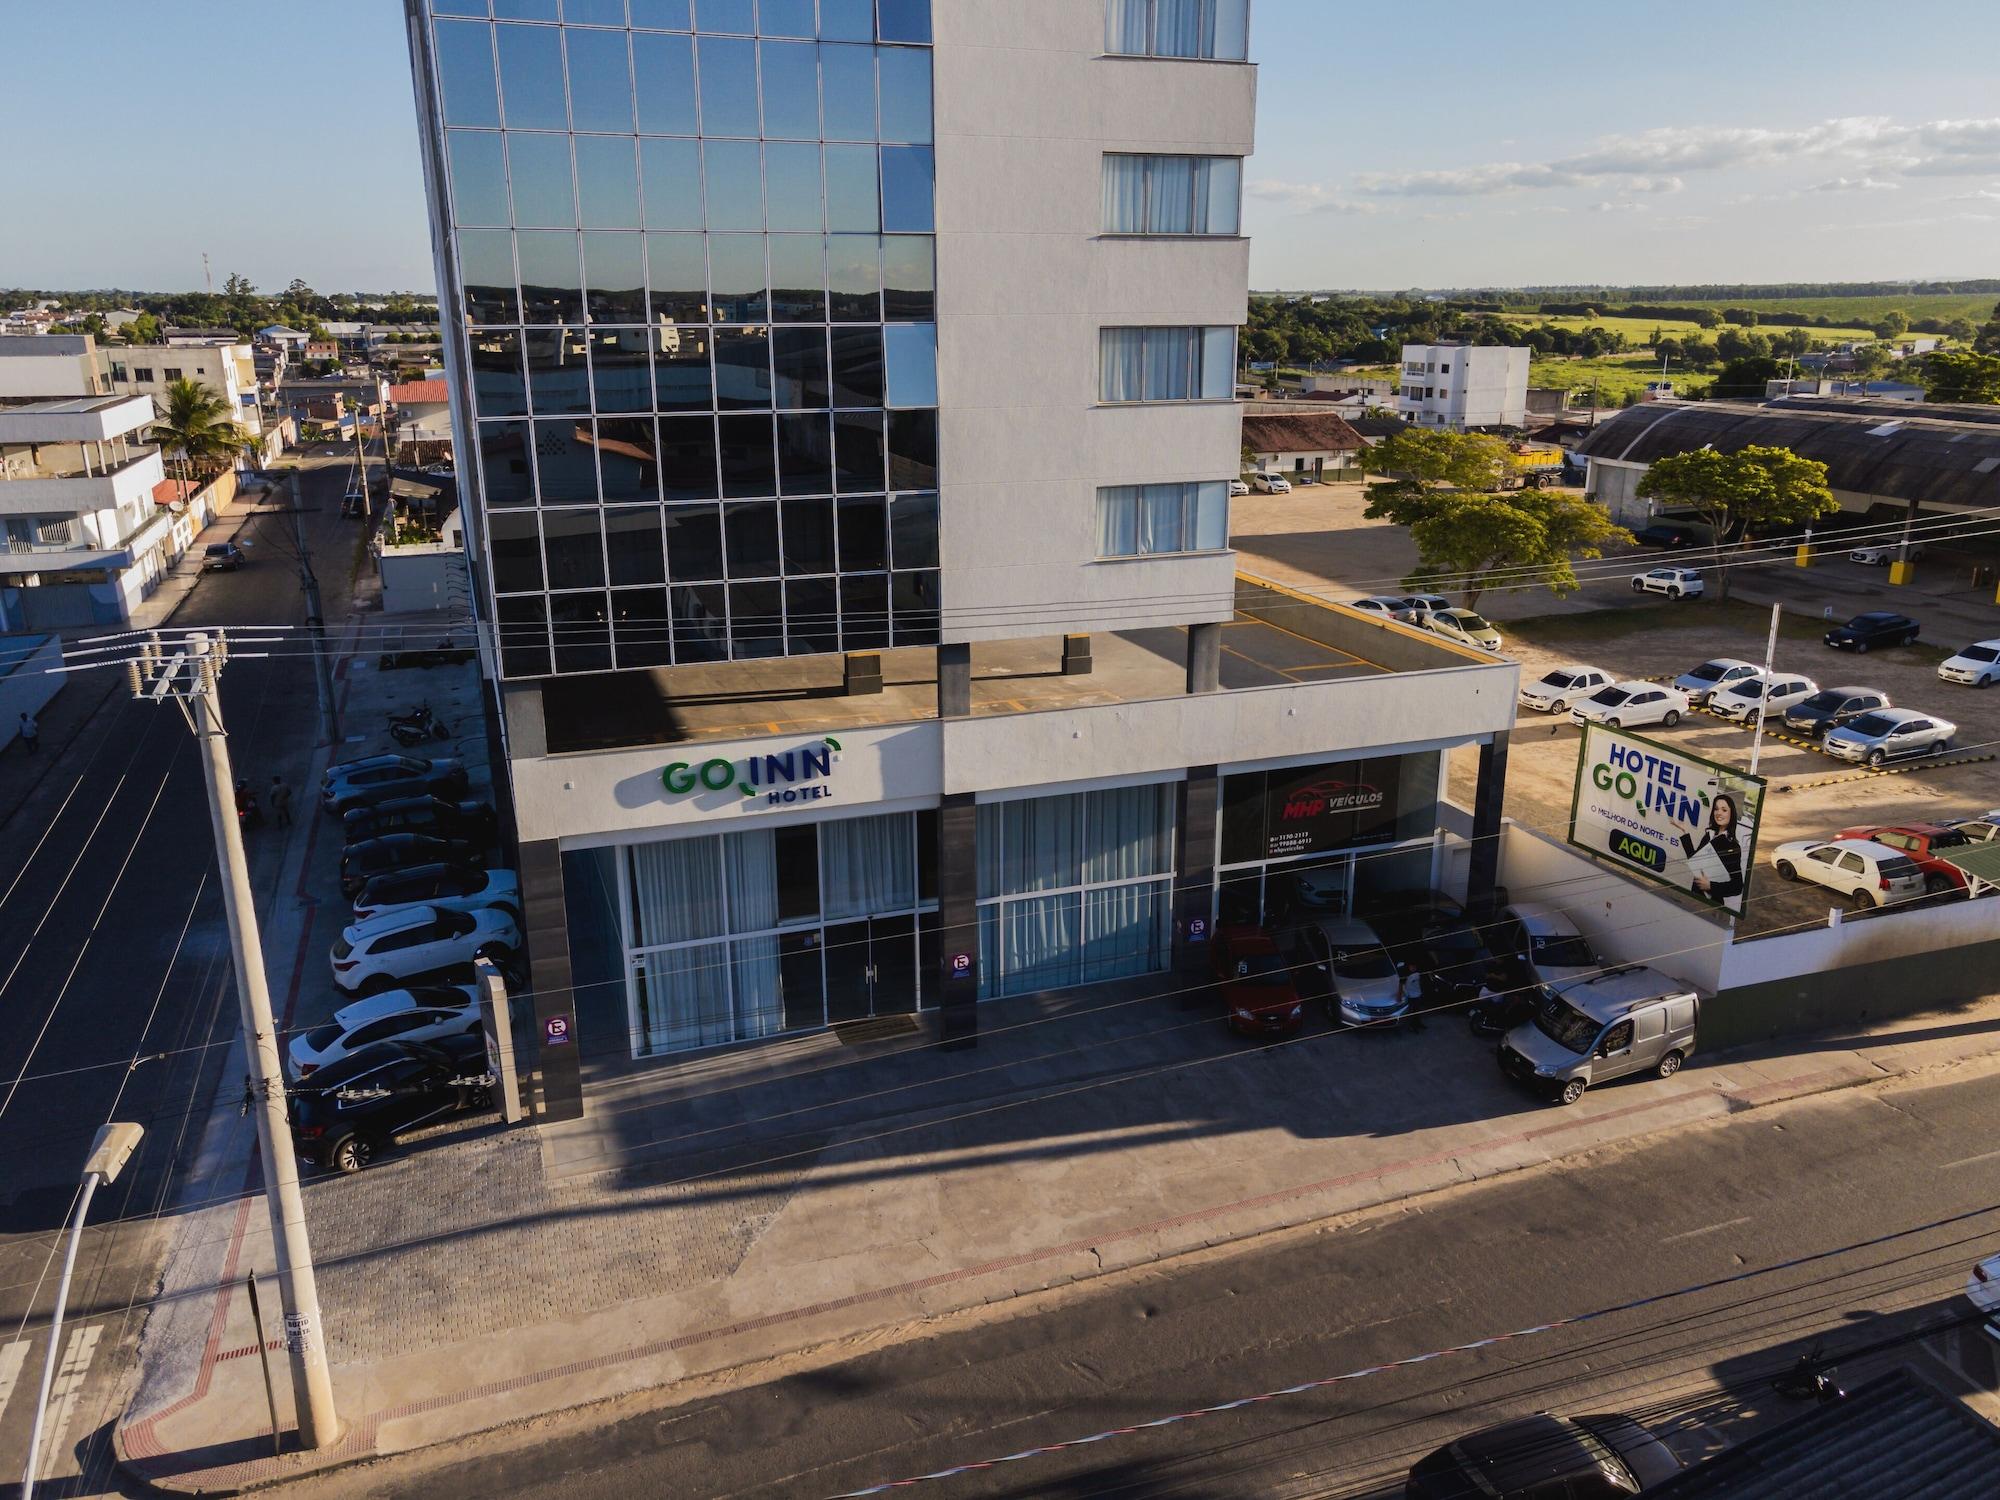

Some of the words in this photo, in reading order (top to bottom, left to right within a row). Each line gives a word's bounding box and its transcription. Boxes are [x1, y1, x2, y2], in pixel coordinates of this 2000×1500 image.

[662, 758, 735, 794] GO
[750, 748, 831, 785] INN
[1609, 743, 1687, 792] HOTEL
[768, 785, 832, 804] HOTEL
[1329, 792, 1383, 808] VEÍCULOS
[1592, 763, 1637, 799] GO
[1644, 782, 1701, 828] INN
[1590, 805, 1597, 813] O
[1598, 808, 1626, 826] MELHOR
[1627, 820, 1638, 830] DO
[1640, 824, 1665, 841] NORTE
[1670, 838, 1680, 847] ES
[1618, 837, 1657, 865] AQUI
